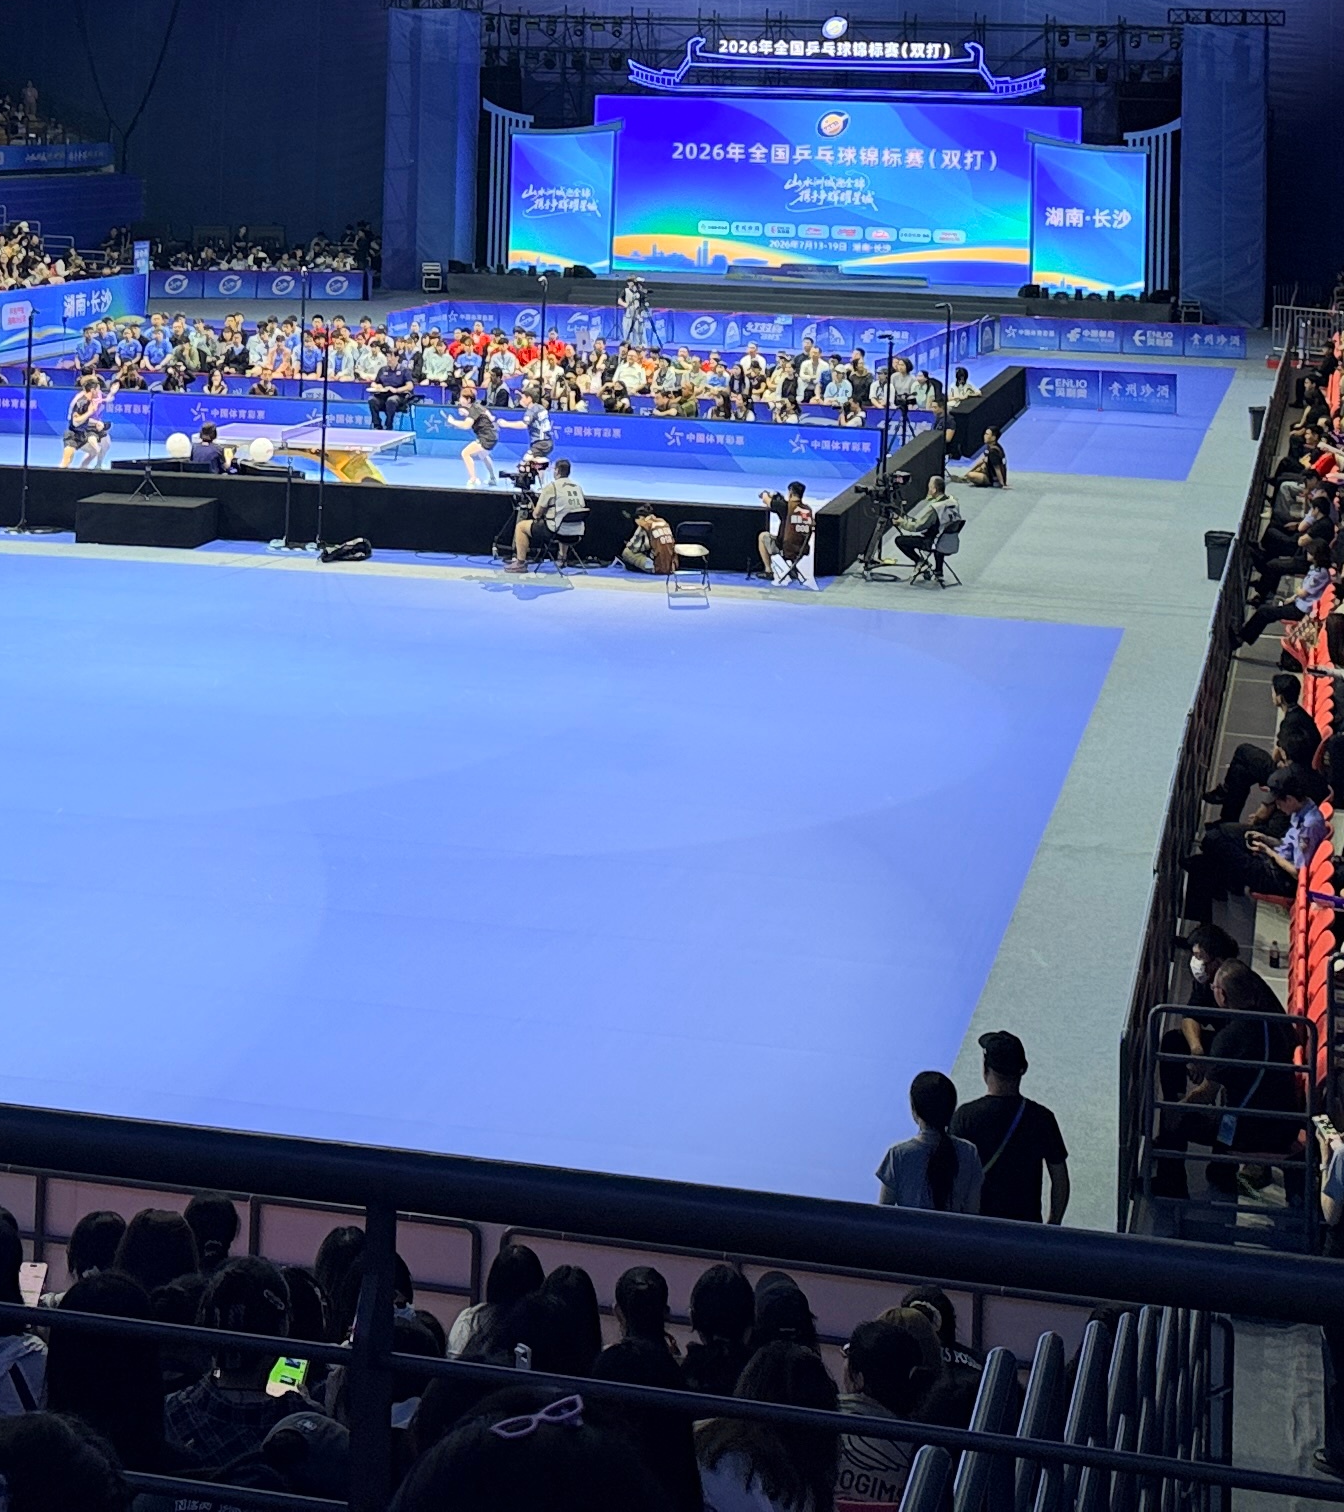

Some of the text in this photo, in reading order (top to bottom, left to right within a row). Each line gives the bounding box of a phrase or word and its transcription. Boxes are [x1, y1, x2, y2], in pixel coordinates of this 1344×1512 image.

[718, 40, 951, 59] 2026年全国乒乓球锦标赛(双打)
[671, 142, 998, 171] 2026年全国乒乓球锦标赛(双打)
[1045, 207, 1132, 228] 湖南·长沙
[63, 287, 113, 319] 湖南·长沙
